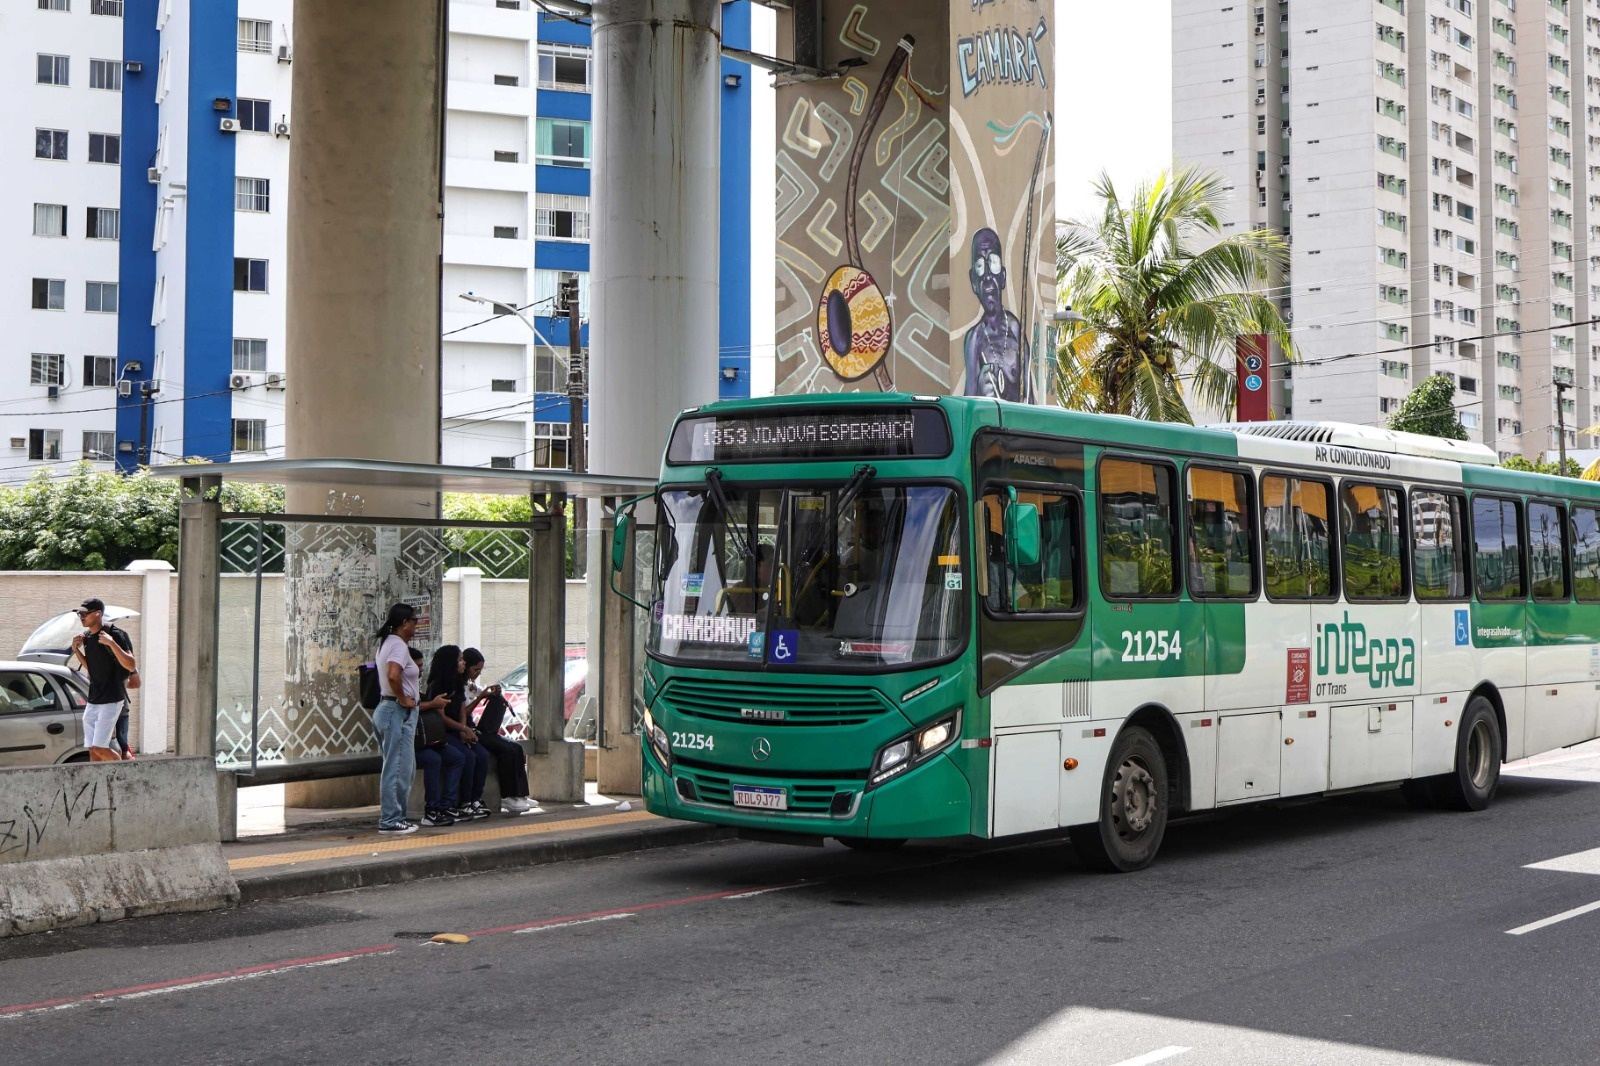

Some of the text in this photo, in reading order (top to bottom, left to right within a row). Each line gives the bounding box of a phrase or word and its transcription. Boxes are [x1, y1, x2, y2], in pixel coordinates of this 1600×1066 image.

[957, 20, 1047, 98] CAMARÁ
[1250, 358, 1257, 368] 2
[703, 428, 747, 446] 1353
[819, 421, 914, 441] ESPERANCA
[1315, 446, 1391, 470] AR CONDICIONADO
[946, 580, 961, 589] G1
[662, 614, 757, 644] CANABRAVA
[1121, 630, 1182, 662] 21254
[1316, 683, 1327, 696] OT
[1328, 682, 1347, 696] Trans
[672, 731, 715, 751] 21254
[738, 792, 781, 807] RDL9J77
